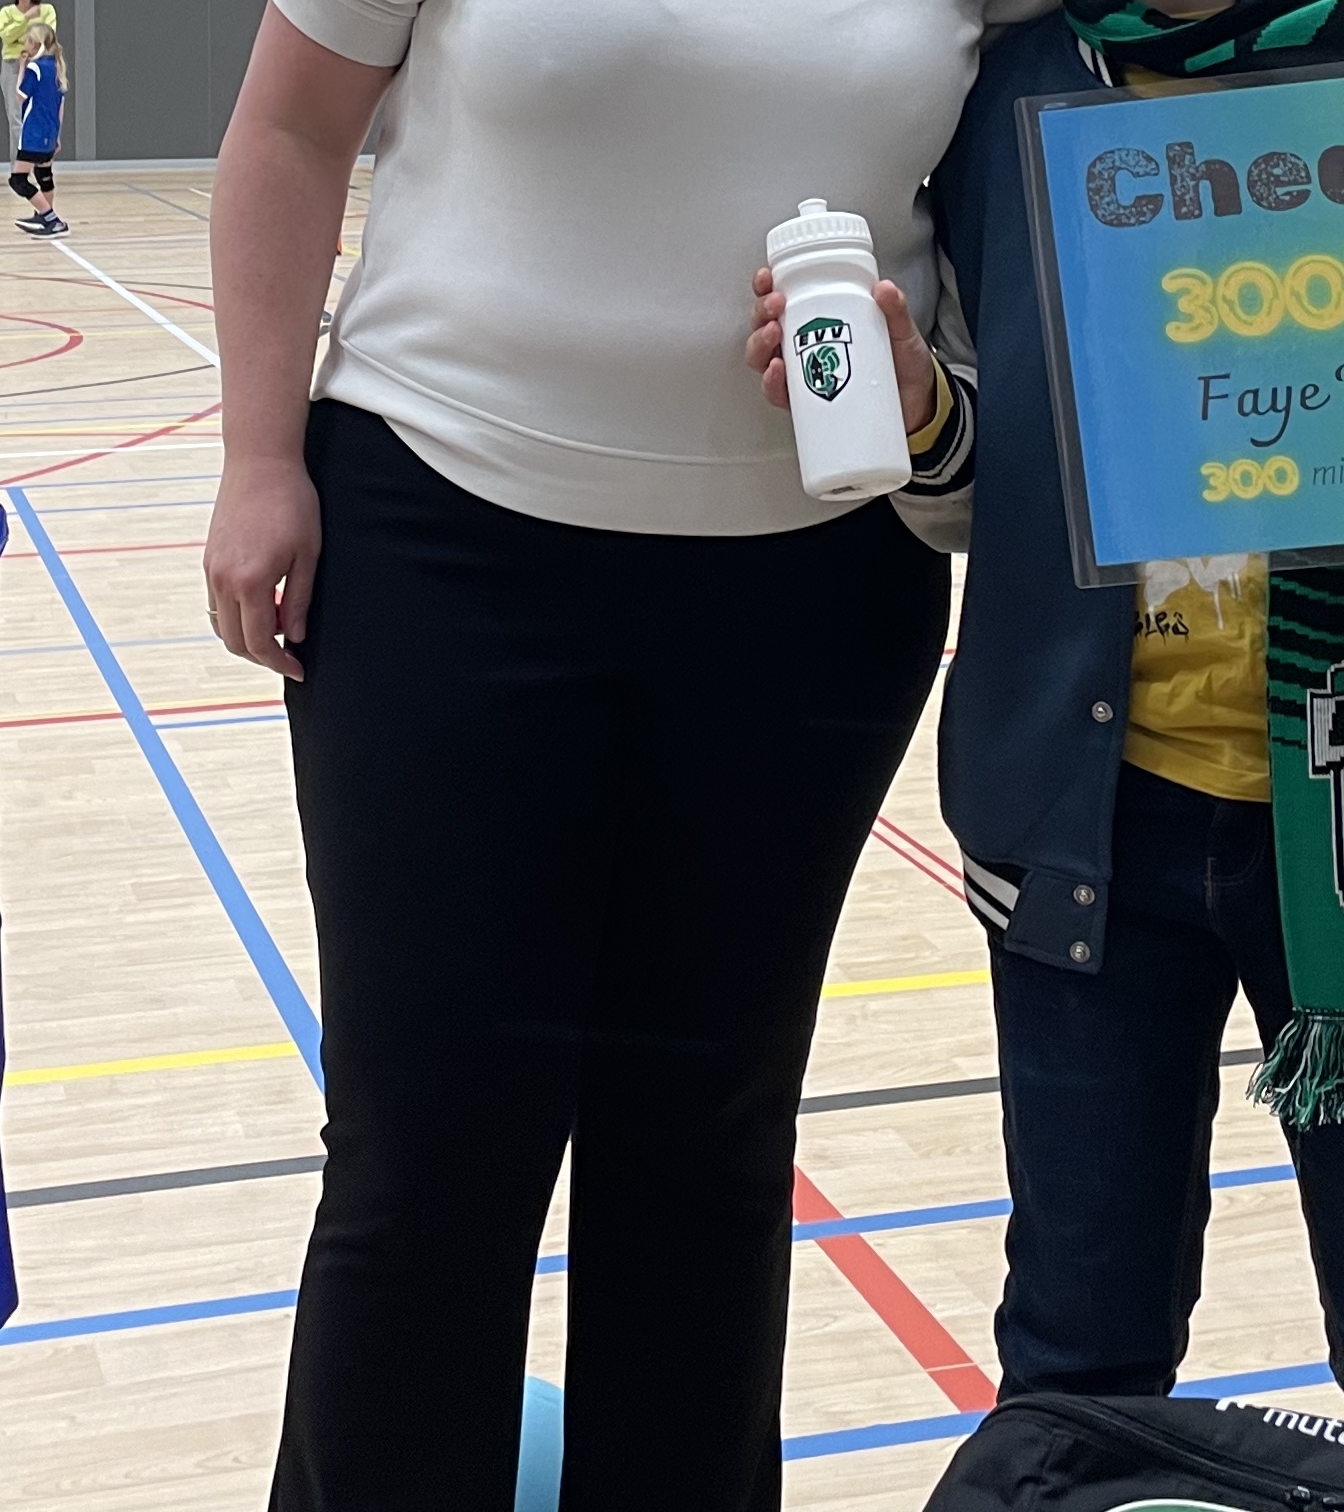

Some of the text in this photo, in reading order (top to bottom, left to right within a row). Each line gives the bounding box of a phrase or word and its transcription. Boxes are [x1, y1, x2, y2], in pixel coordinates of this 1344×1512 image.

[799, 325, 843, 348] EVV
[1197, 372, 1332, 448] Faye
[1200, 454, 1300, 503] 300
